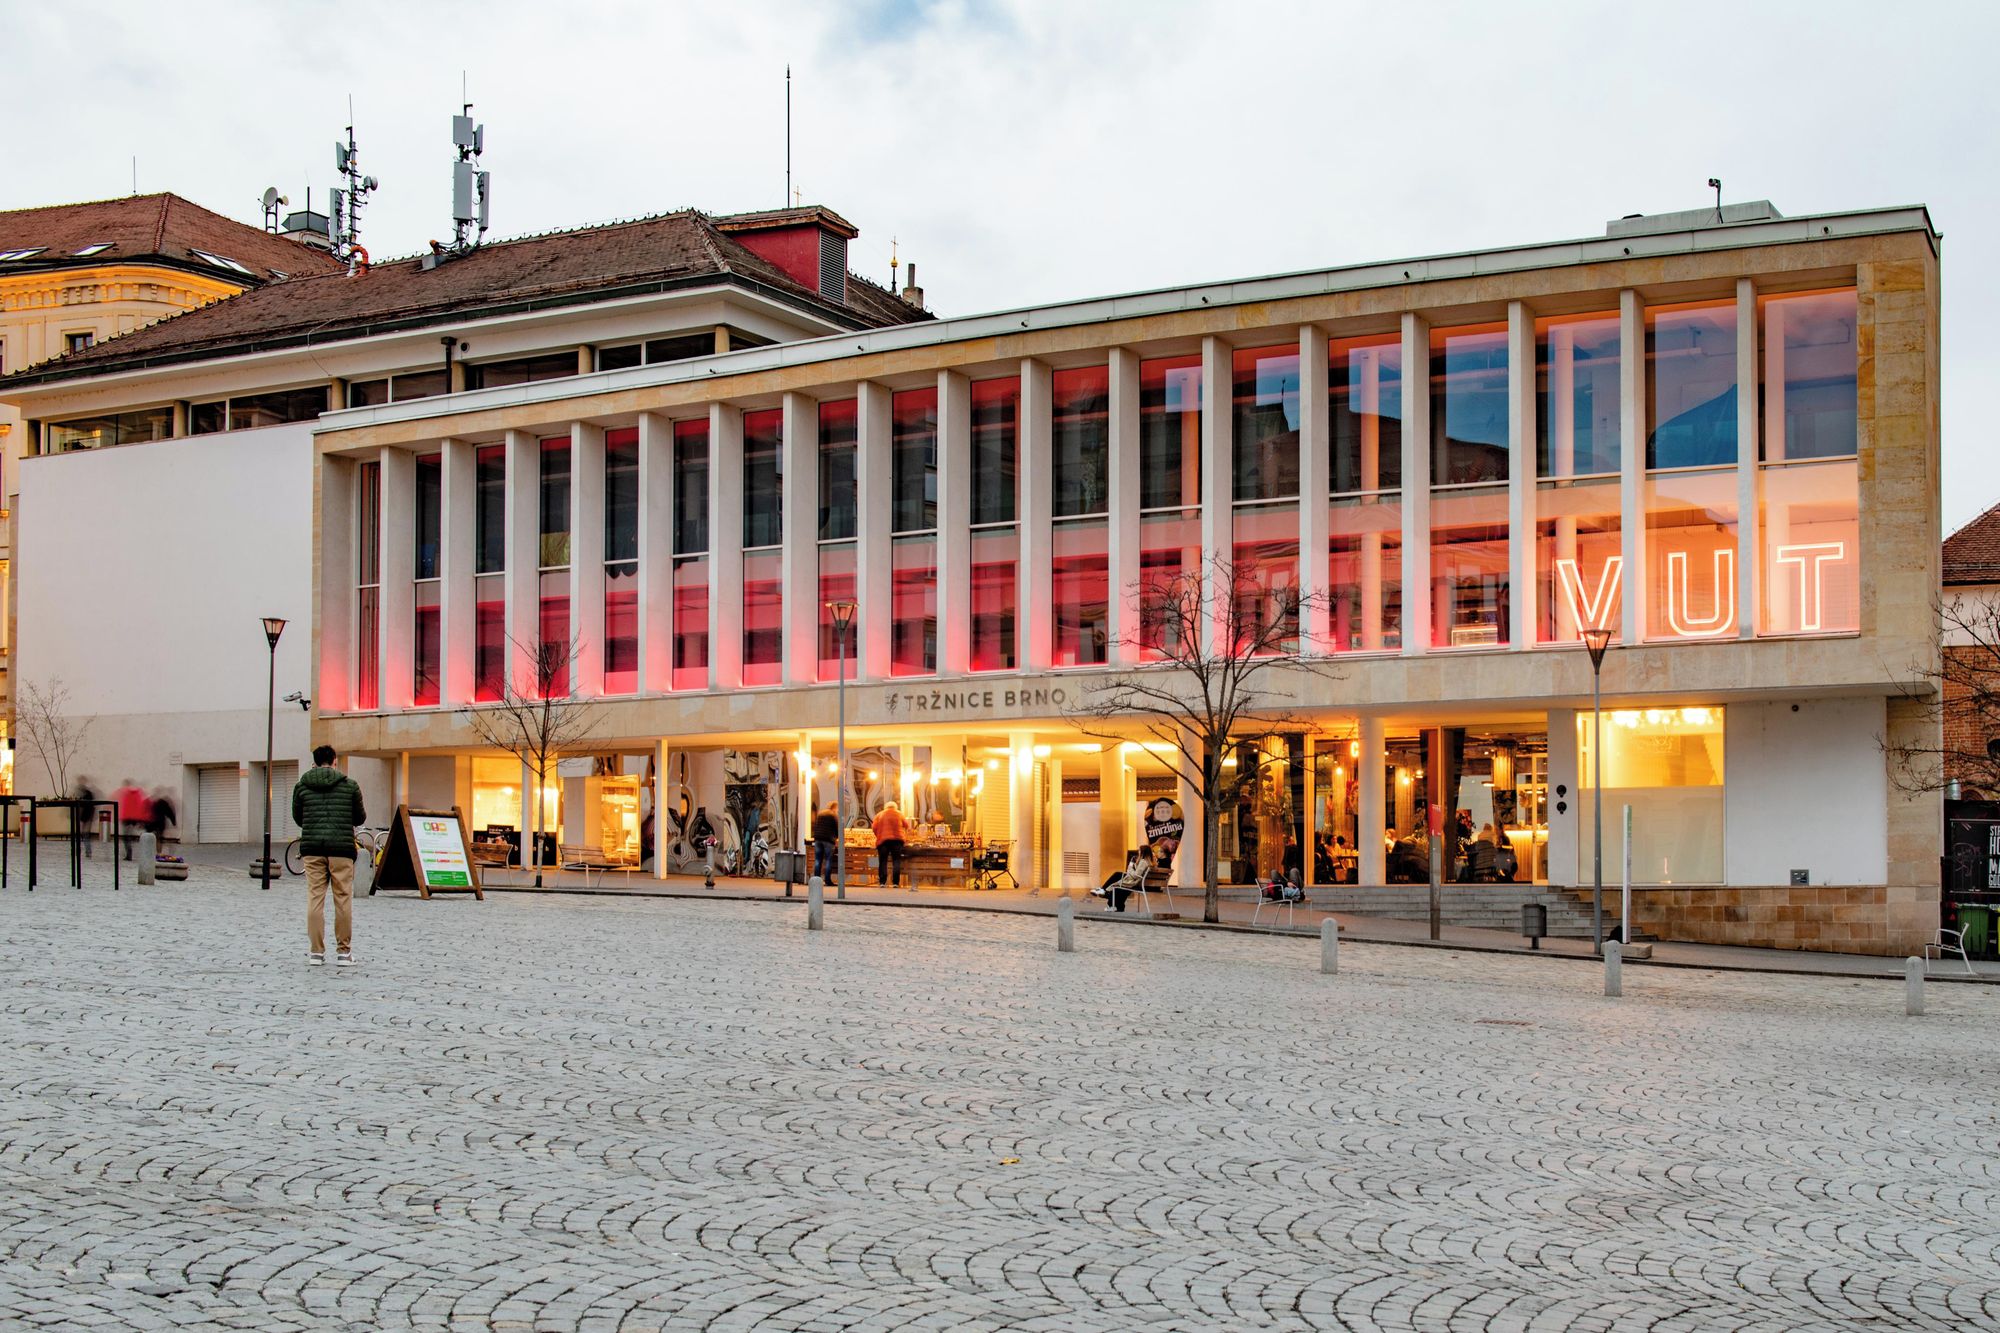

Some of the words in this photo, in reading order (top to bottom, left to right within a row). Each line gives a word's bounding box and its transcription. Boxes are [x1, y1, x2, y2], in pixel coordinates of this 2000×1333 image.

[1556, 541, 1844, 641] VUT
[904, 689, 994, 712] TRŽNICE
[1005, 688, 1067, 707] BRNO
